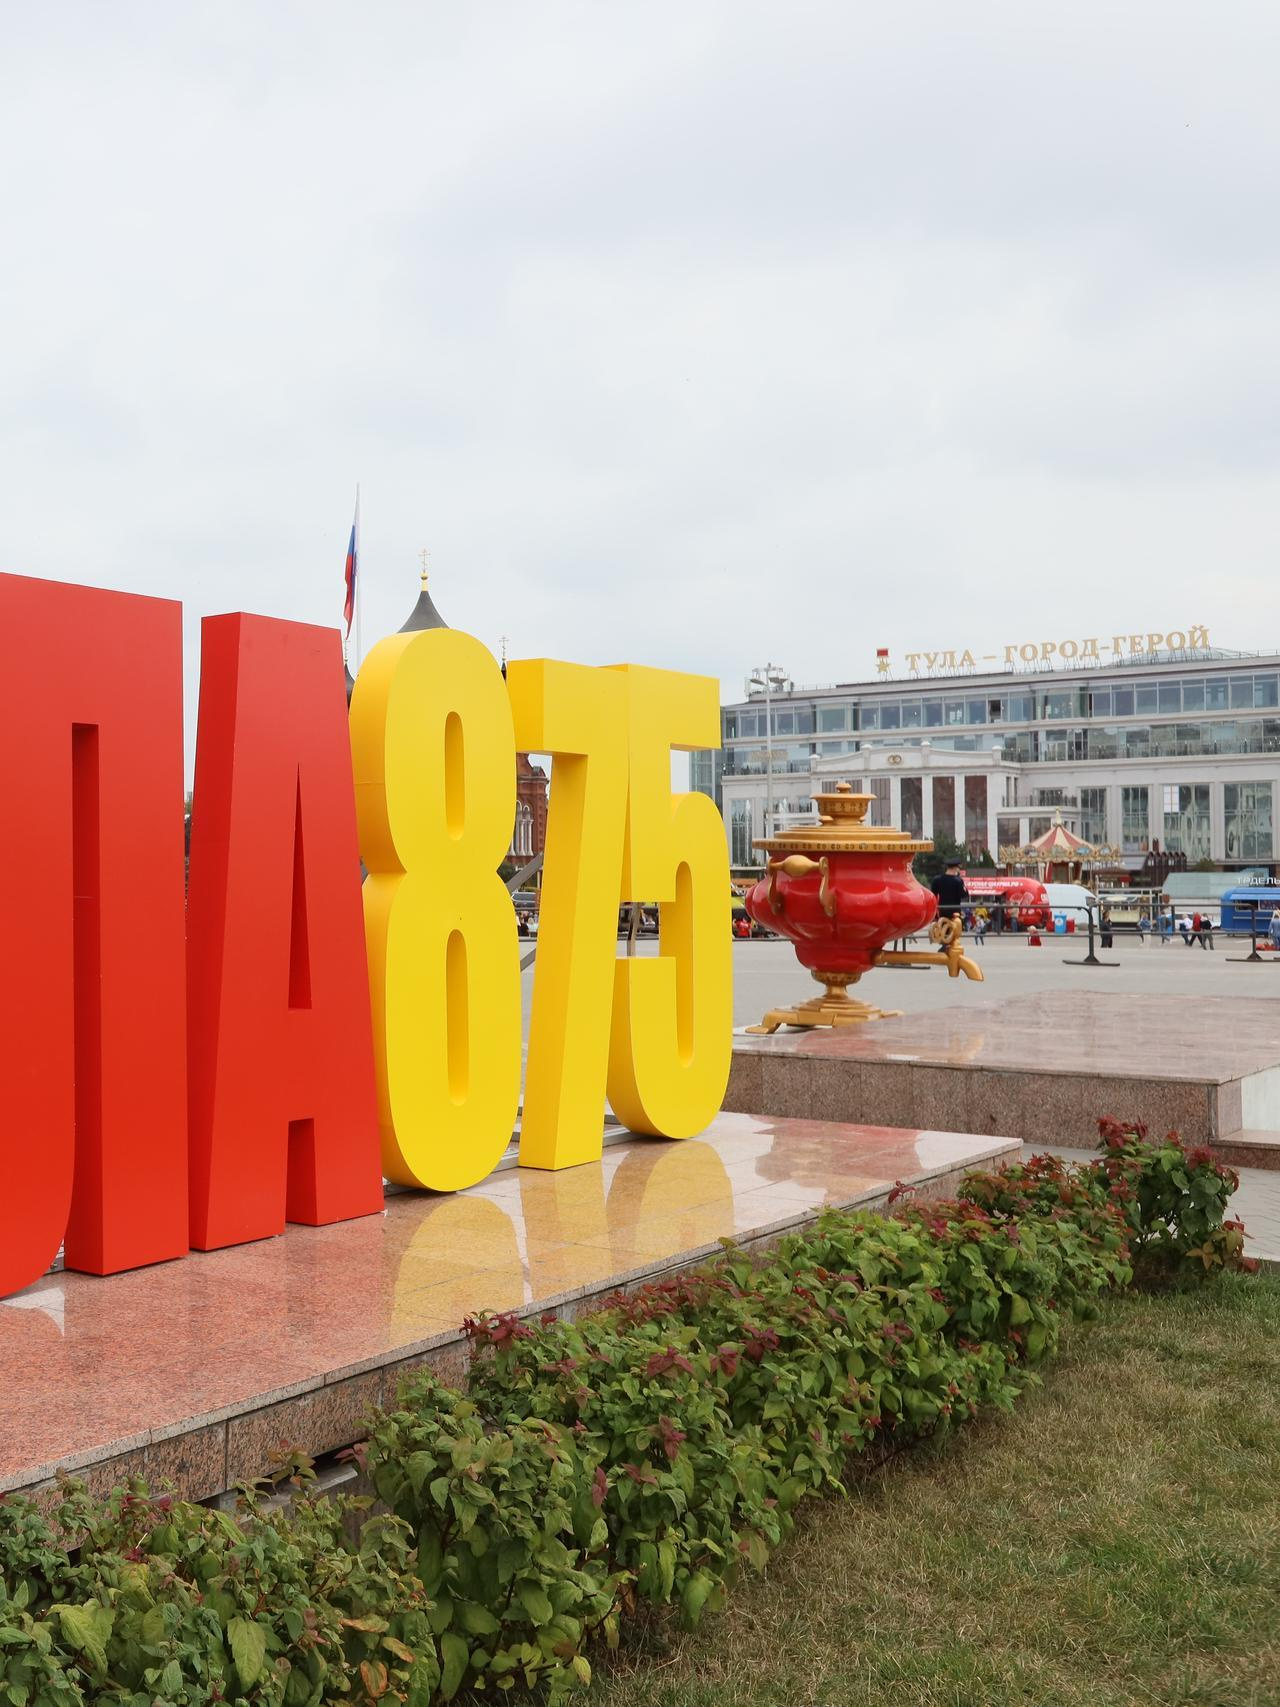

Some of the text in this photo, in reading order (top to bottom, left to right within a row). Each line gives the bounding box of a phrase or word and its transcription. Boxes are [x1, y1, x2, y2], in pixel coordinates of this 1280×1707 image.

[904, 648, 977, 671] ТУЛА
[1003, 624, 1211, 664] ГОРОД-ГЕРОЙ
[348, 628, 734, 1193] 875
